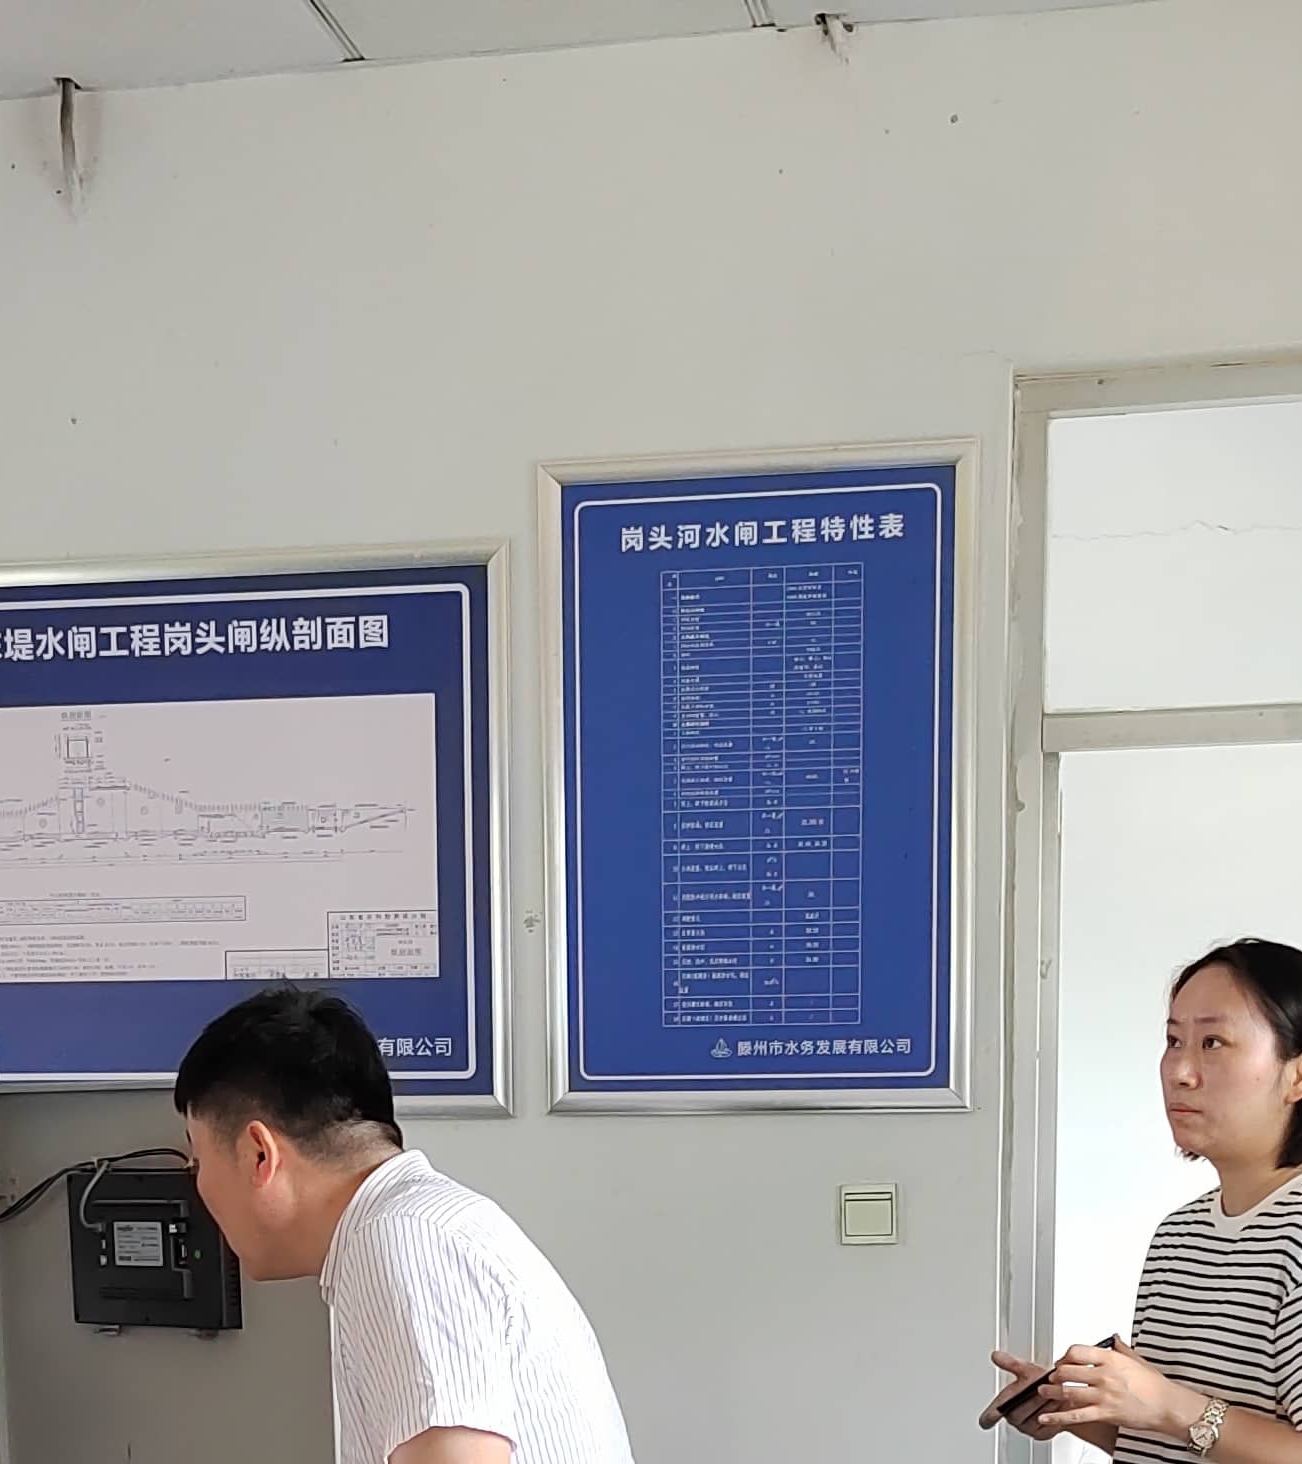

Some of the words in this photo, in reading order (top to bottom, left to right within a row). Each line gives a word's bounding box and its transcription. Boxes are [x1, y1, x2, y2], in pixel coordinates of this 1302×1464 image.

[620, 513, 905, 552] 岗头河水闸工程特性表
